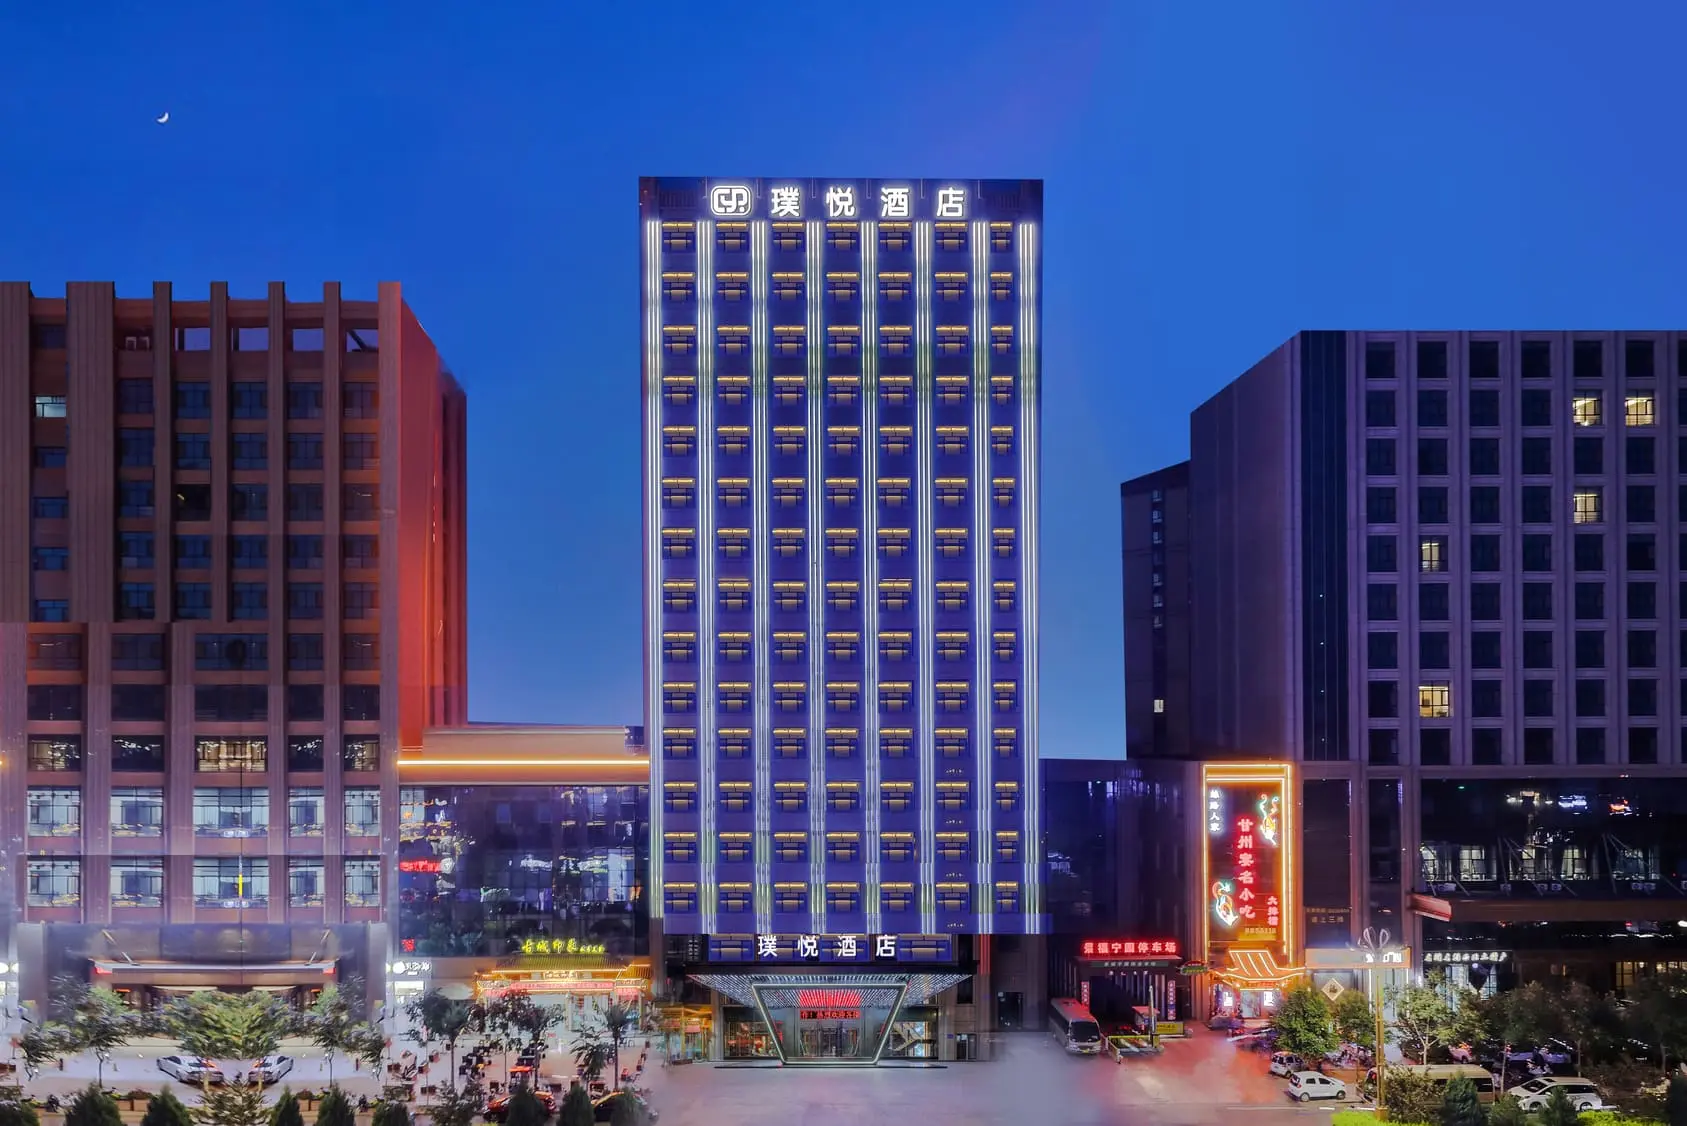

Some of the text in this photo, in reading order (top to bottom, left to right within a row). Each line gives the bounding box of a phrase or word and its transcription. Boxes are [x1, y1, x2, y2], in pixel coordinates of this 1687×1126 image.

[771, 187, 964, 217] 璞悦酒店
[757, 935, 898, 957] 璞悦酒店
